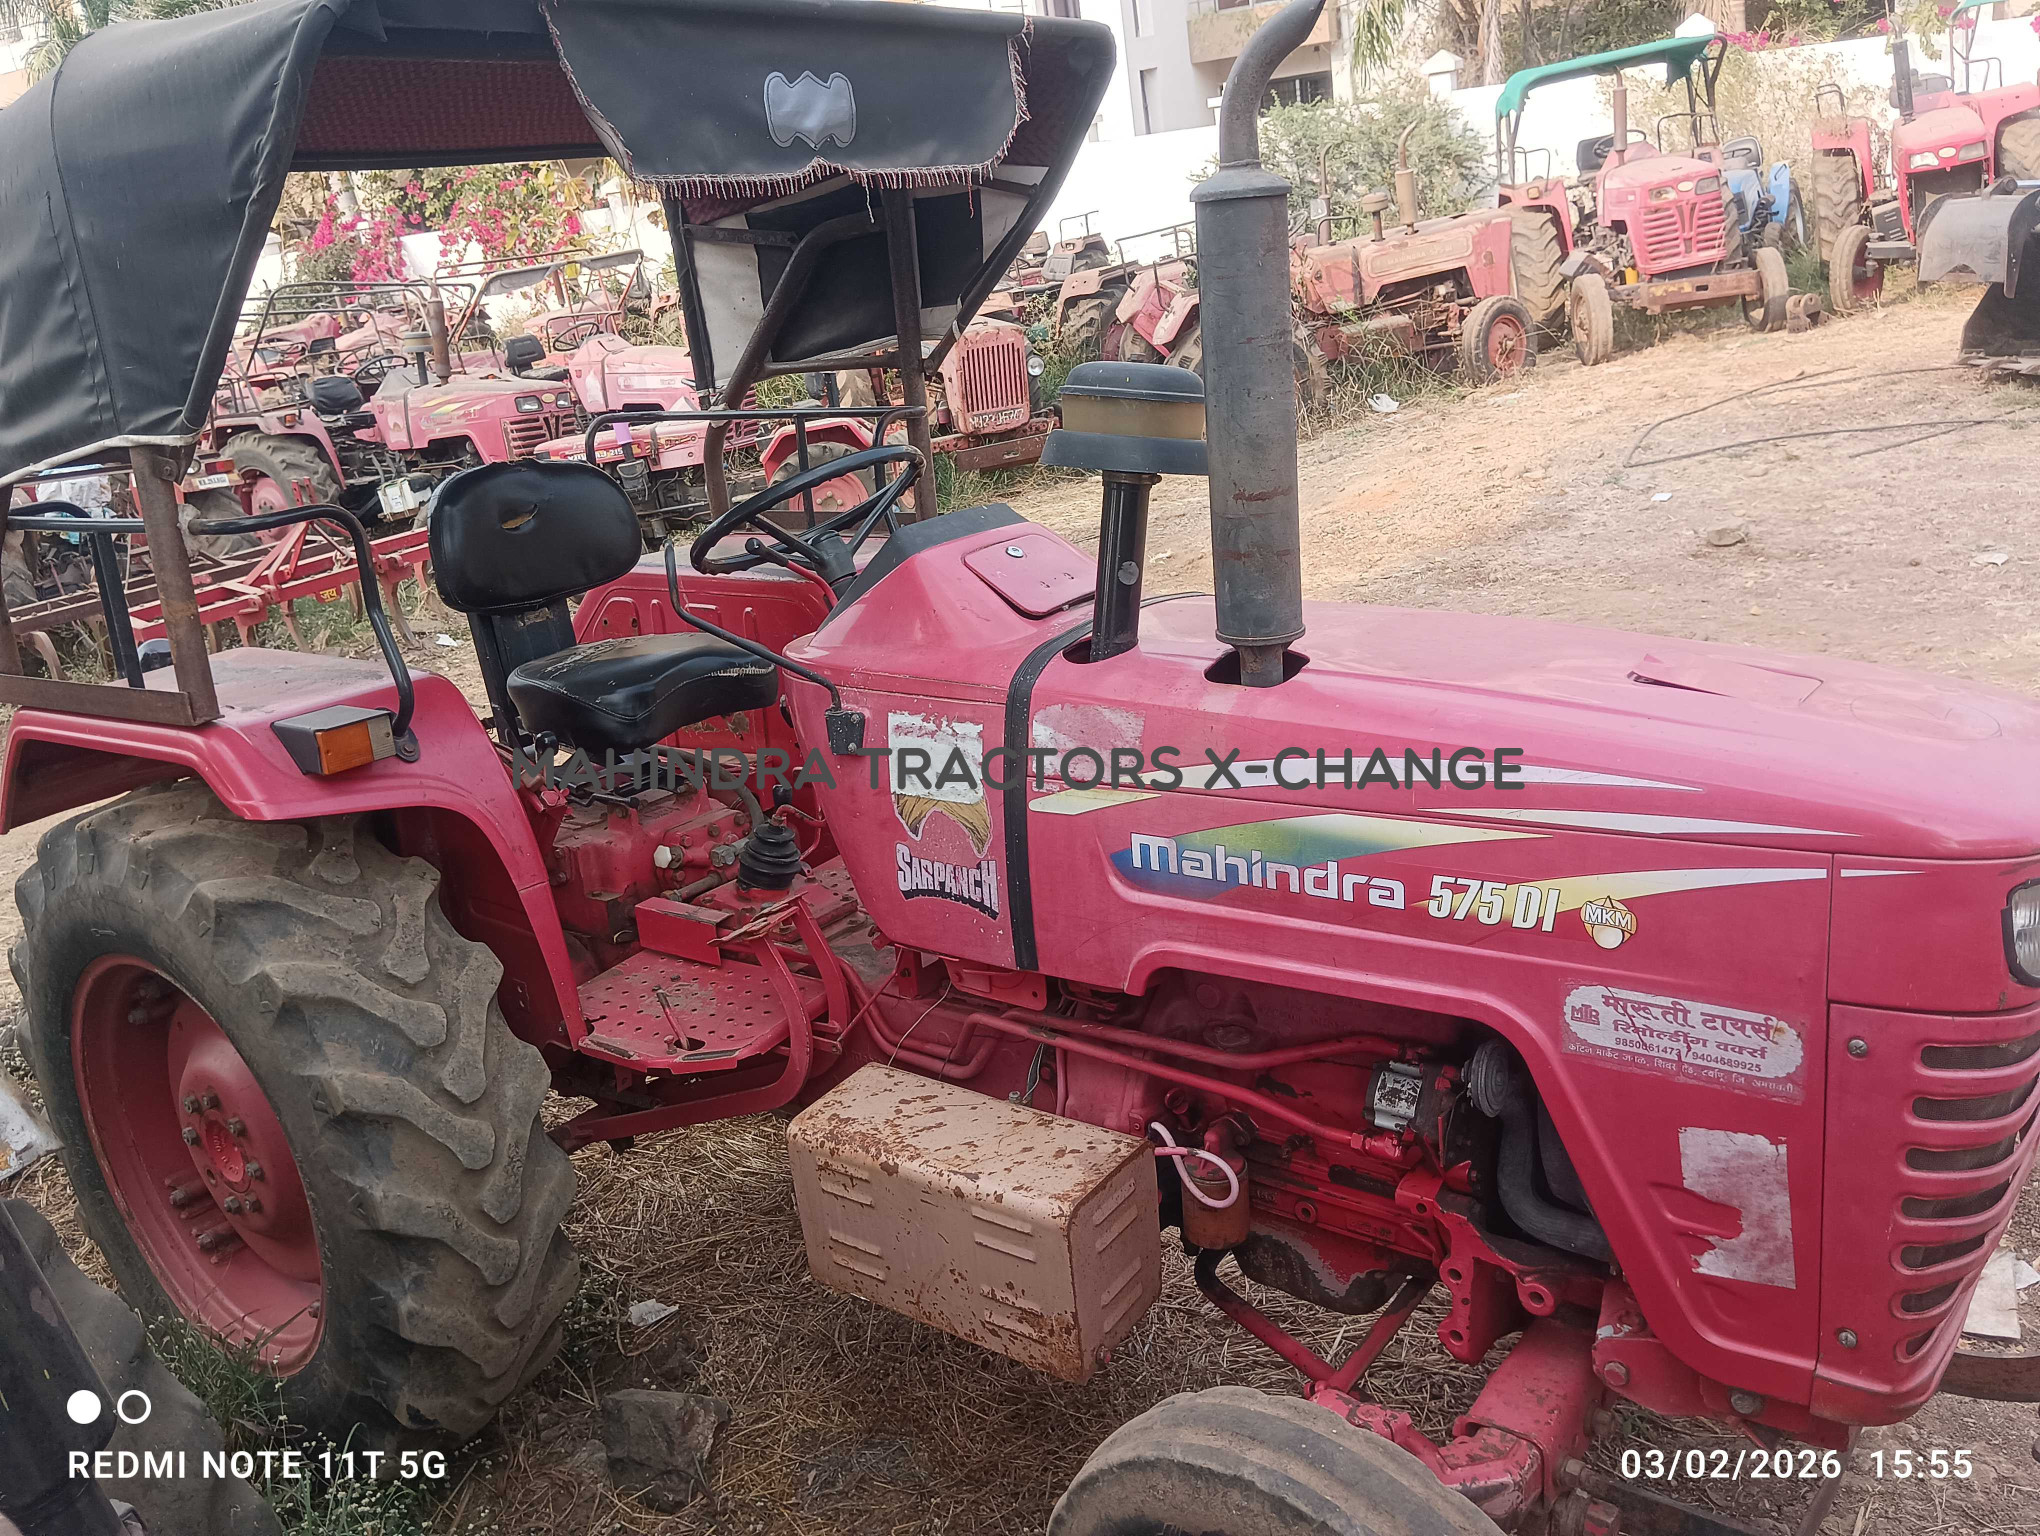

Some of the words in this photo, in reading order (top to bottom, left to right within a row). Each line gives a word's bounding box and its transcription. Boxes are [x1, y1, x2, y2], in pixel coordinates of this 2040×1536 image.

[896, 842, 999, 918] SARPANCH
[1427, 873, 1509, 922] 575
[1510, 882, 1562, 934] DI
[1584, 901, 1633, 932] MKM
[1571, 1004, 1600, 1026] MTR
